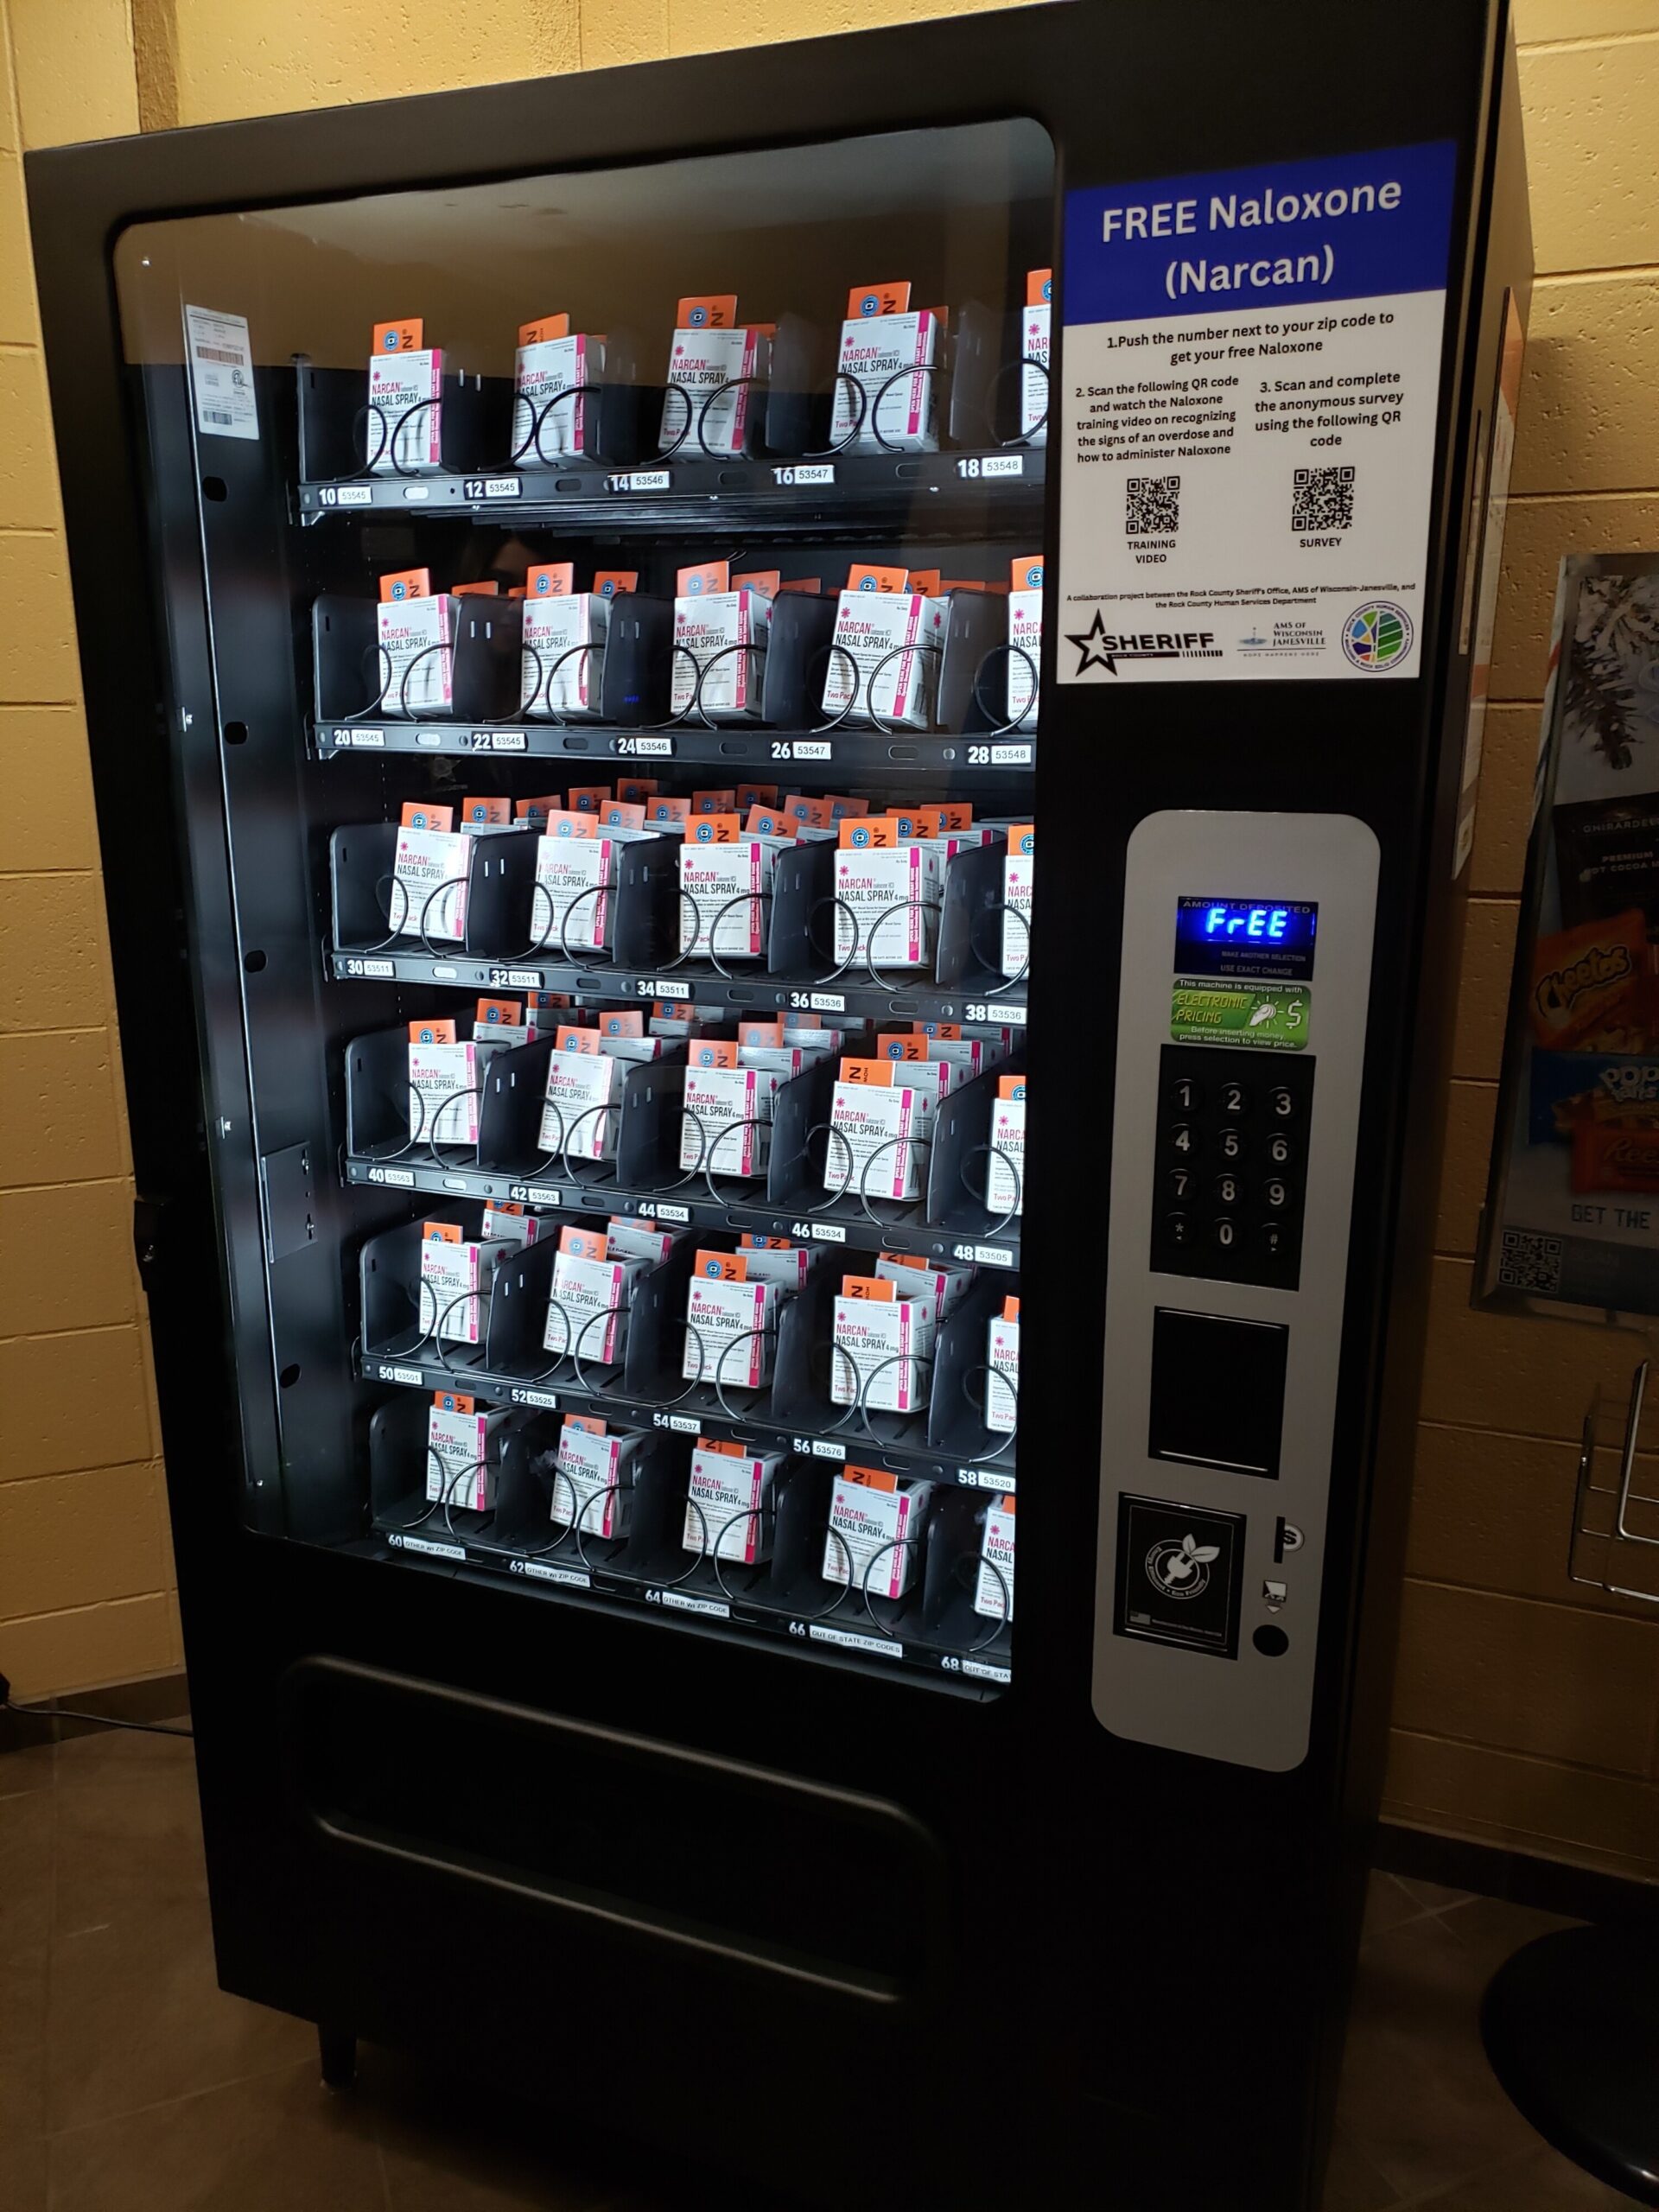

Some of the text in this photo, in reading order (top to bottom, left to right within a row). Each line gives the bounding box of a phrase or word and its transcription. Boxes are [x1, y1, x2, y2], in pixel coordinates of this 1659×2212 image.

[1103, 181, 1402, 243] FREE Naloxone
[1166, 245, 1334, 299] (Narcan)
[1107, 312, 1394, 348] 1.Push the number next to your zip code to
[1171, 340, 1323, 365] get your free Naloxone
[842, 358, 898, 374] NASAL SPRAY
[1076, 376, 1238, 397] 2. Scan the following QR code
[1260, 372, 1401, 392] 3. Scan and complete
[1090, 394, 1223, 412] and watch the Naloxone
[1255, 392, 1403, 412] the anonymous survey
[1077, 410, 1236, 430] training video on recognizing
[1255, 411, 1401, 432] using the following QR
[1078, 427, 1234, 447] the signs of an overdose and
[1310, 435, 1342, 447] code
[1077, 444, 1230, 463] how to administer Naloxone
[957, 459, 1018, 477] 18 53548
[466, 481, 515, 499] 12 53545
[609, 475, 664, 491] 14 53546
[1128, 539, 1176, 550] TRAINING
[1300, 537, 1342, 548] SURVEY
[1135, 554, 1166, 564] VIDEO
[1102, 633, 1213, 651] SHERIFF
[1273, 638, 1325, 646] JANESVILLE
[968, 746, 1026, 764] 28 53548
[838, 890, 893, 902] NASAL SPRAY
[1184, 901, 1238, 910] AMOUNT
[1262, 967, 1293, 976] CHANGE
[637, 981, 686, 996] 34 53511
[1244, 984, 1282, 993] equipped
[1536, 944, 1632, 1019] Cheetos
[791, 992, 841, 1008] 36 53536
[1177, 995, 1248, 1008] ELECTRONIC
[1176, 1009, 1222, 1023] PRICING
[1179, 1033, 1201, 1042] press
[1204, 1035, 1240, 1044] selection
[1219, 1028, 1255, 1037] inserting
[1179, 1085, 1291, 1115] 1 2 3
[1175, 1131, 1287, 1160] 4 5 6
[1175, 1176, 1285, 1205] 7 8 9
[1572, 1205, 1649, 1229] GET THE
[792, 1223, 841, 1238] 46 53534
[1219, 1224, 1232, 1245] 0
[954, 1244, 1007, 1262] 48 53505
[836, 1335, 886, 1351] NASAL SPRAY
[652, 1414, 697, 1431] 54 53537
[794, 1439, 842, 1456] 56 53576
[957, 1470, 1011, 1488] 58 53520
[789, 1622, 805, 1636] 66
[876, 1642, 899, 1652] CODES
